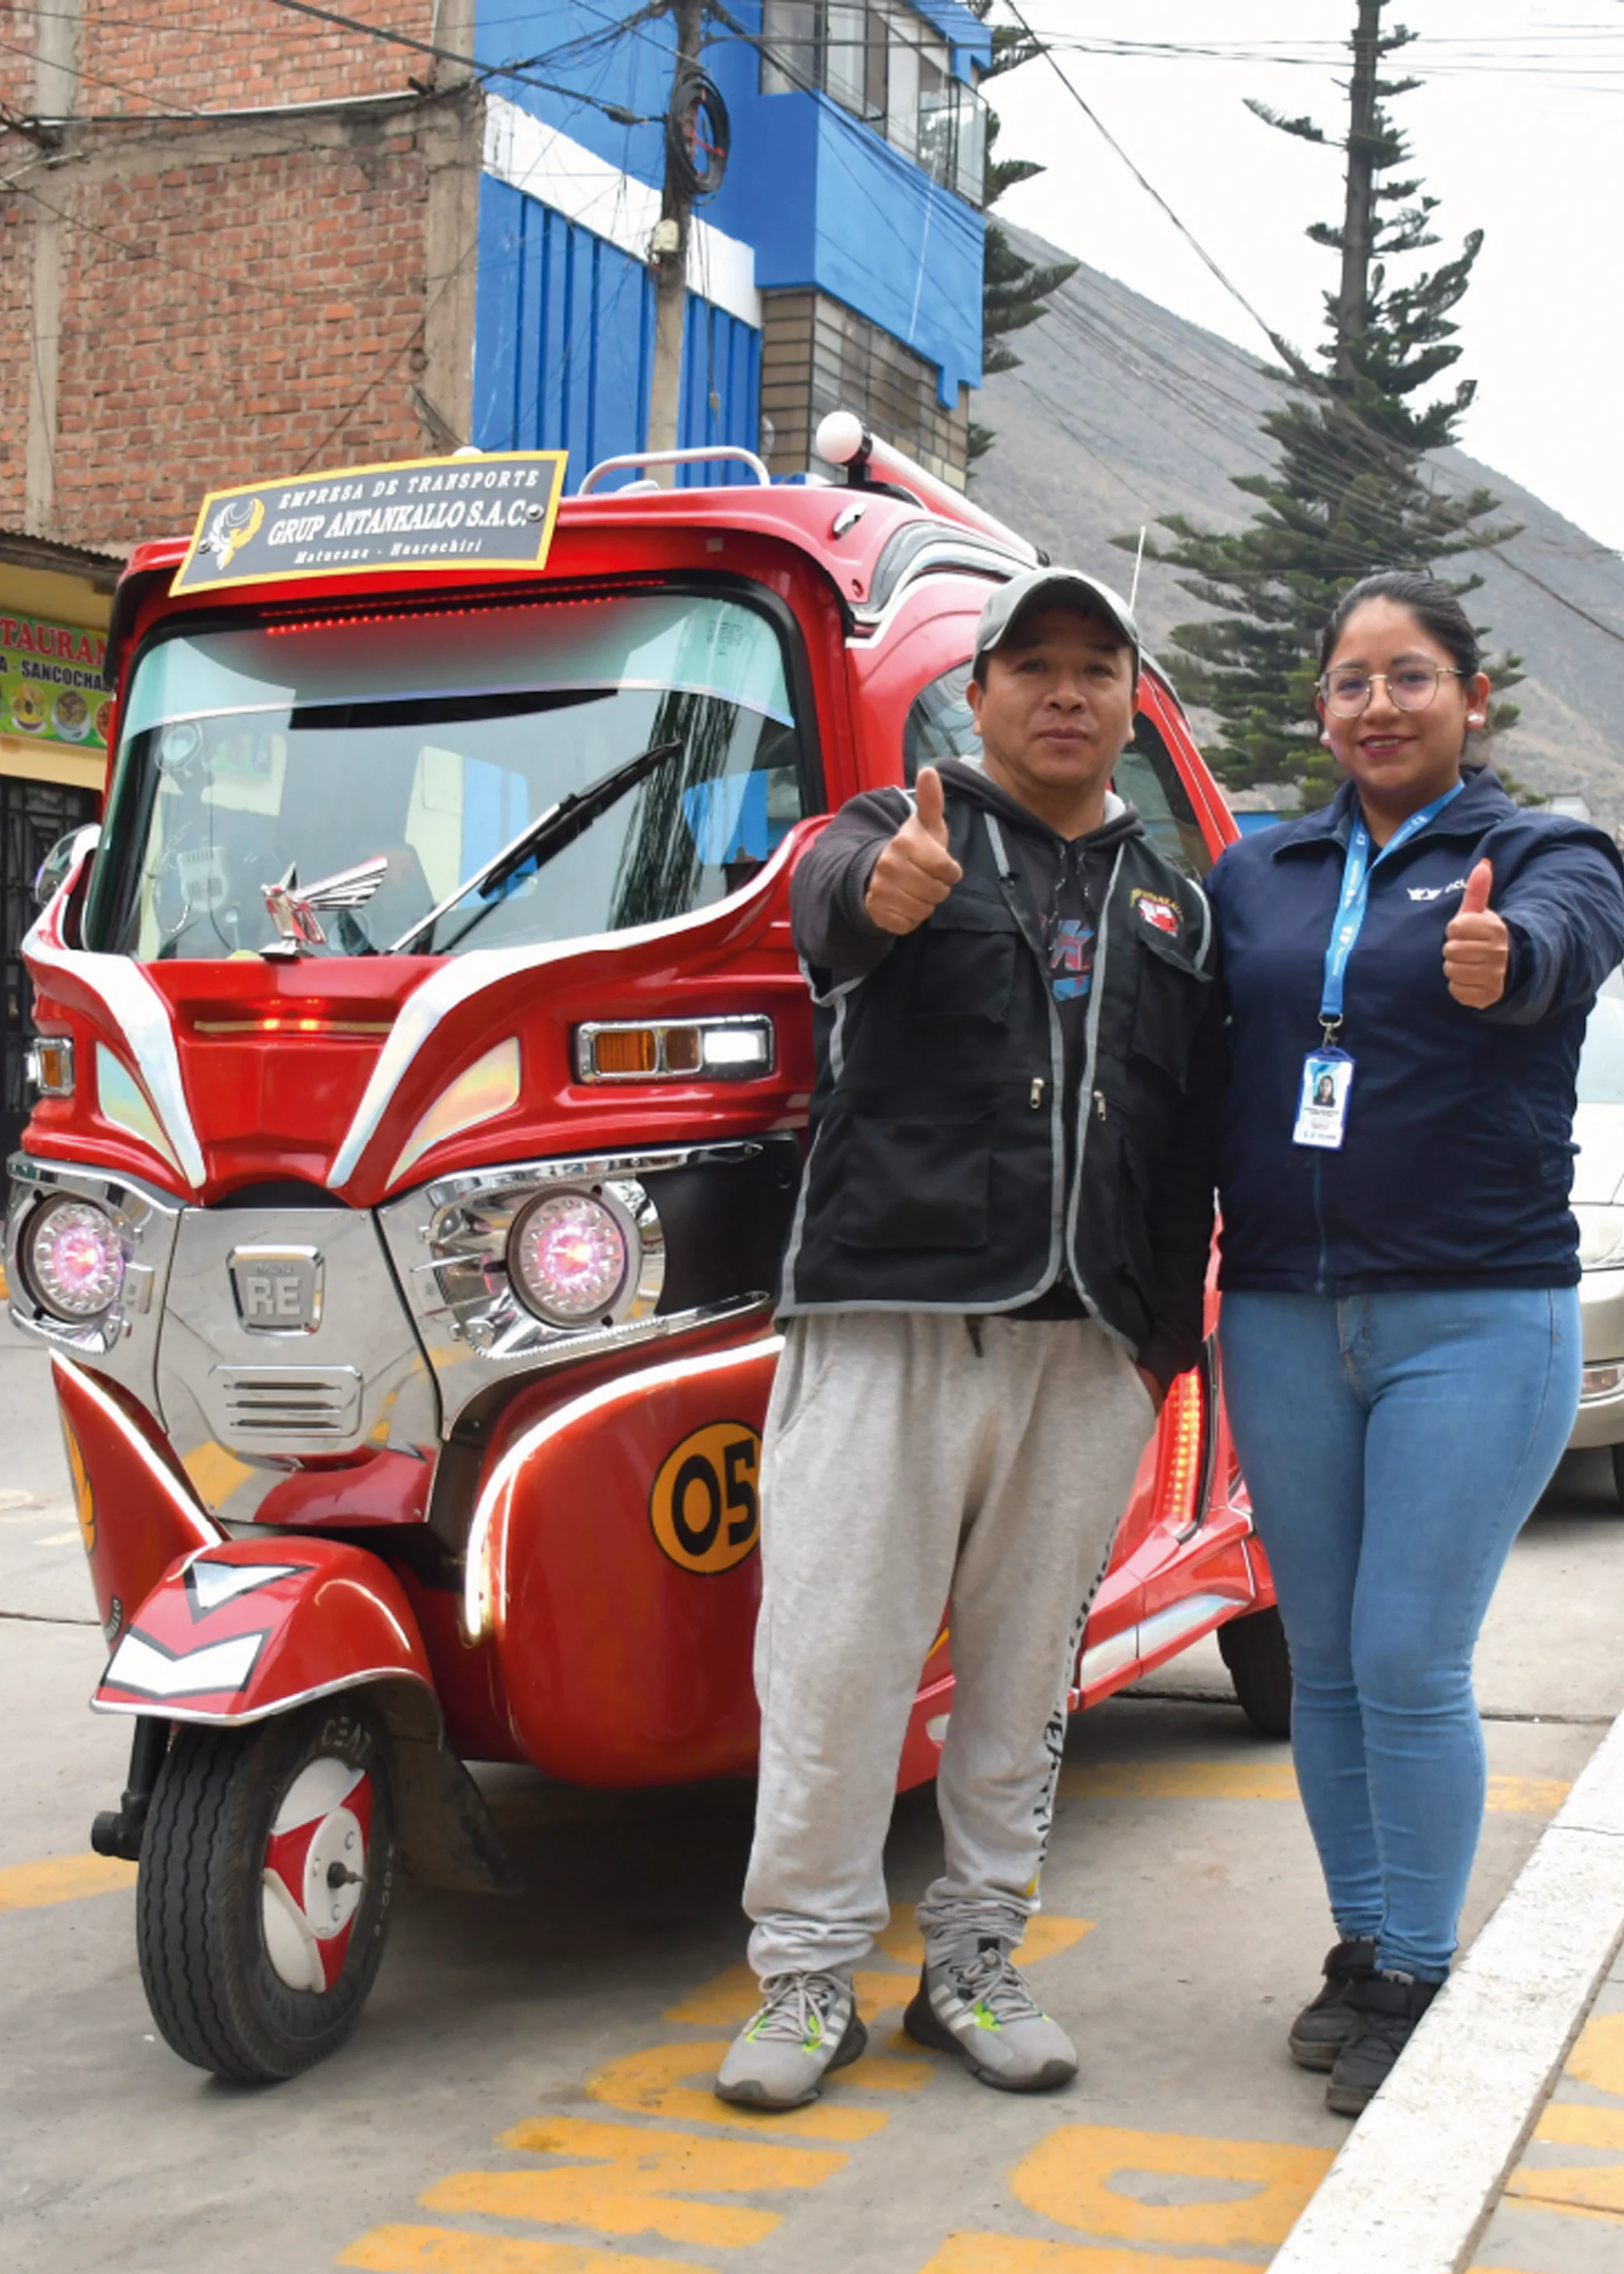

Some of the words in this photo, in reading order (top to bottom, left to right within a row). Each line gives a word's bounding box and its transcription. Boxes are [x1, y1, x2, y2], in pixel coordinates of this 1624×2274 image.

[278, 483, 363, 509] EMPRESA
[371, 478, 398, 497] DE
[407, 469, 540, 493] TRANSPORTE
[267, 514, 325, 546] GRUP
[324, 500, 465, 539] ANTANKALLO
[465, 499, 527, 527] S.A.C.
[294, 549, 370, 564] Matucana
[246, 1276, 301, 1315] RE
[671, 1437, 757, 1557] 05
